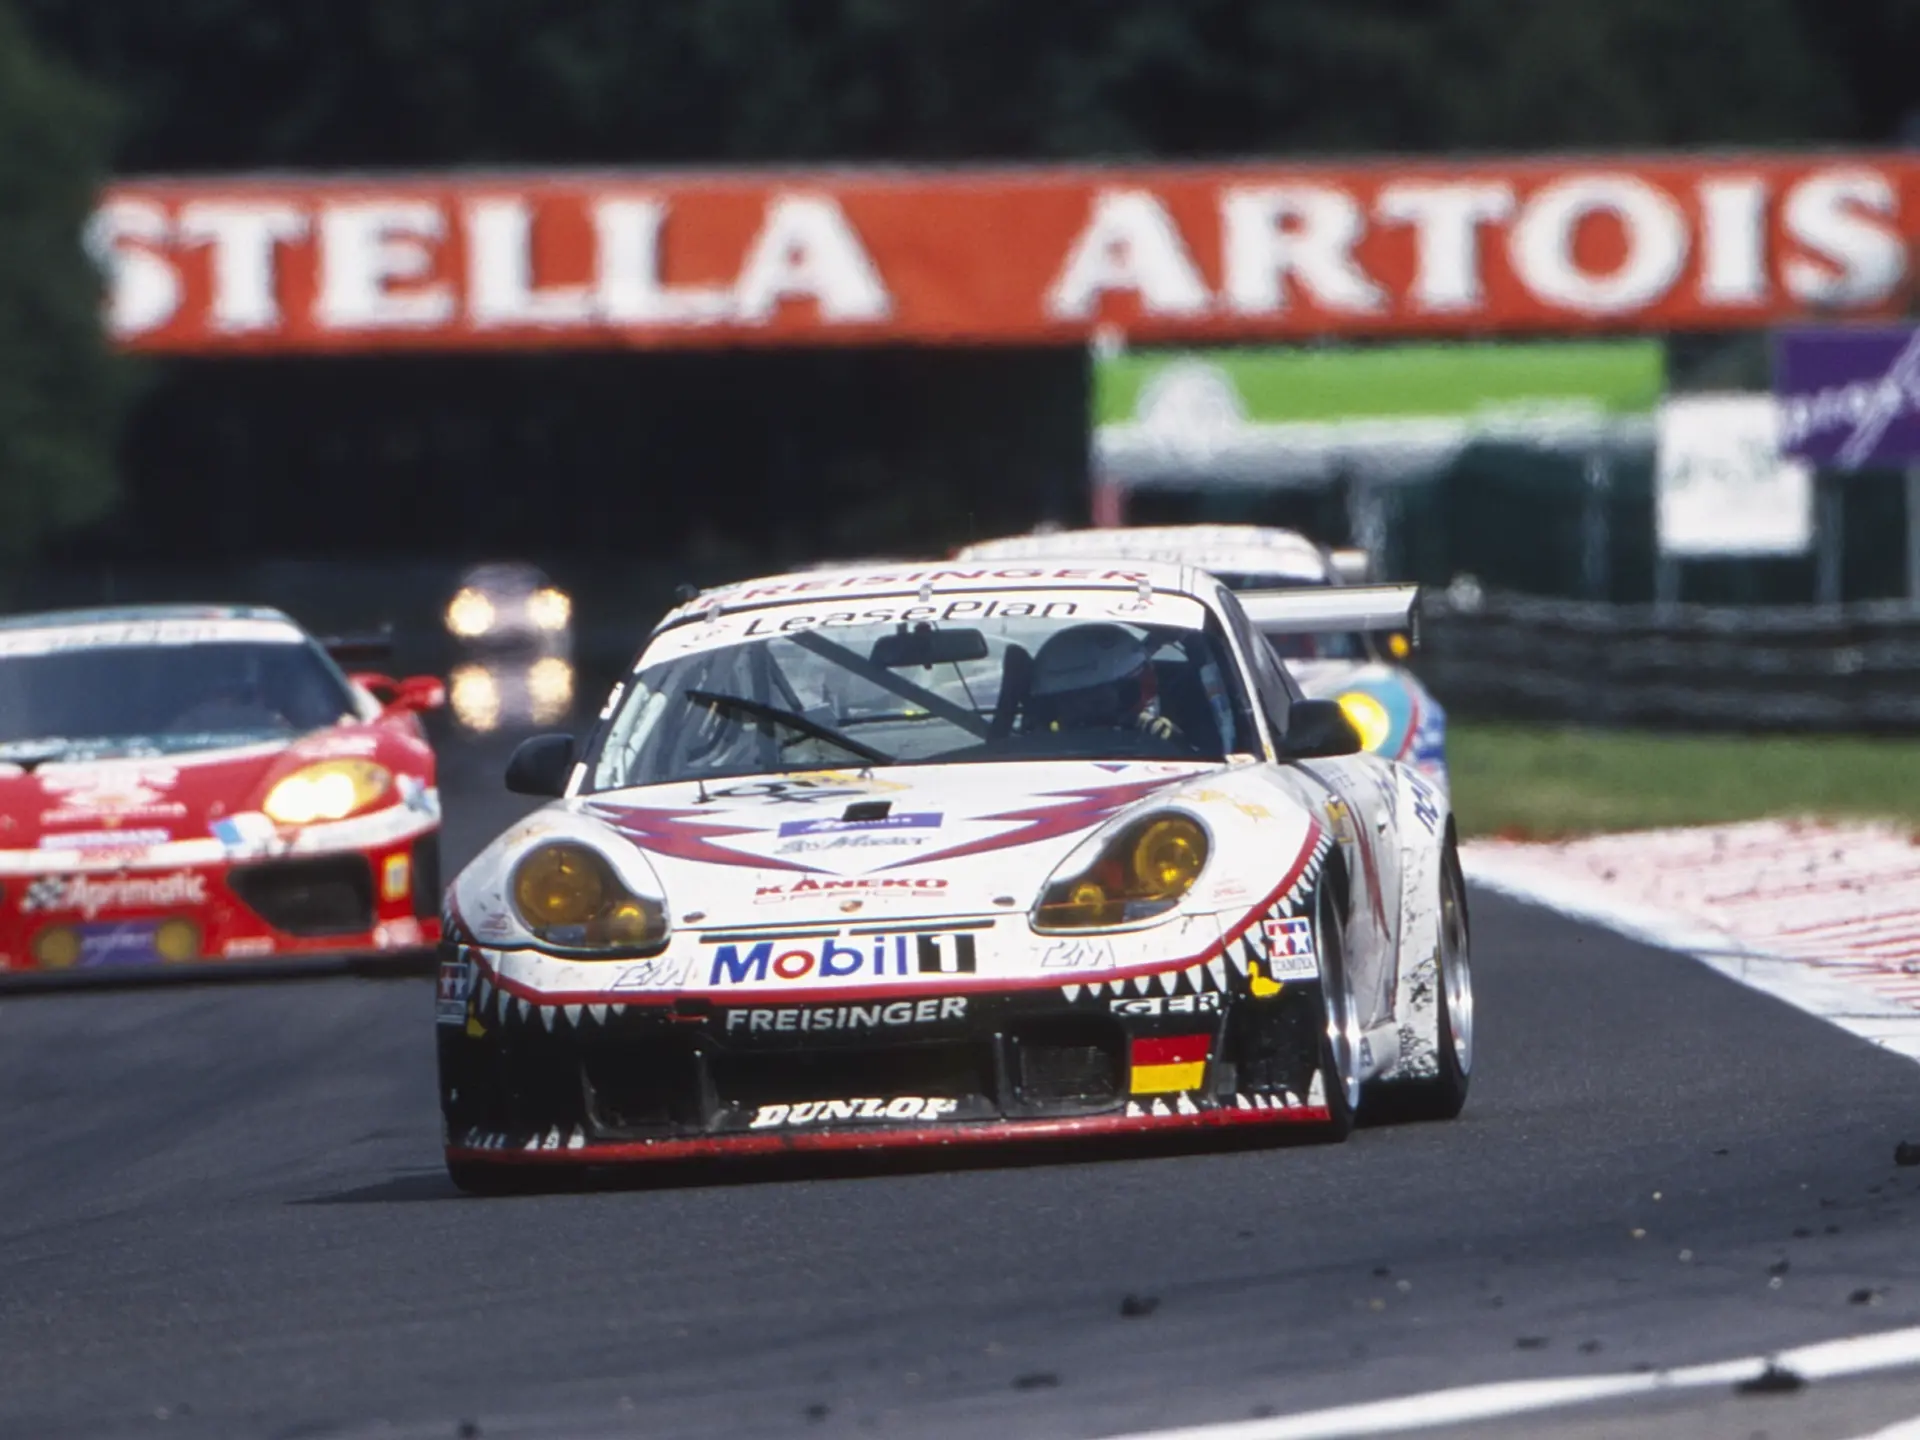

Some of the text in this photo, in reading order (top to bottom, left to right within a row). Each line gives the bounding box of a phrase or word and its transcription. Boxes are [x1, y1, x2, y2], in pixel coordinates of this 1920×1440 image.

[80, 166, 1907, 338] STELLA ARTOIS
[698, 568, 1149, 609] FREISINGER
[742, 599, 1079, 637] LeasePlan
[755, 879, 948, 896] KANEKO
[709, 935, 908, 986] Mobil
[725, 996, 968, 1031] FREISINGER
[749, 1097, 958, 1128] DUNLOP
